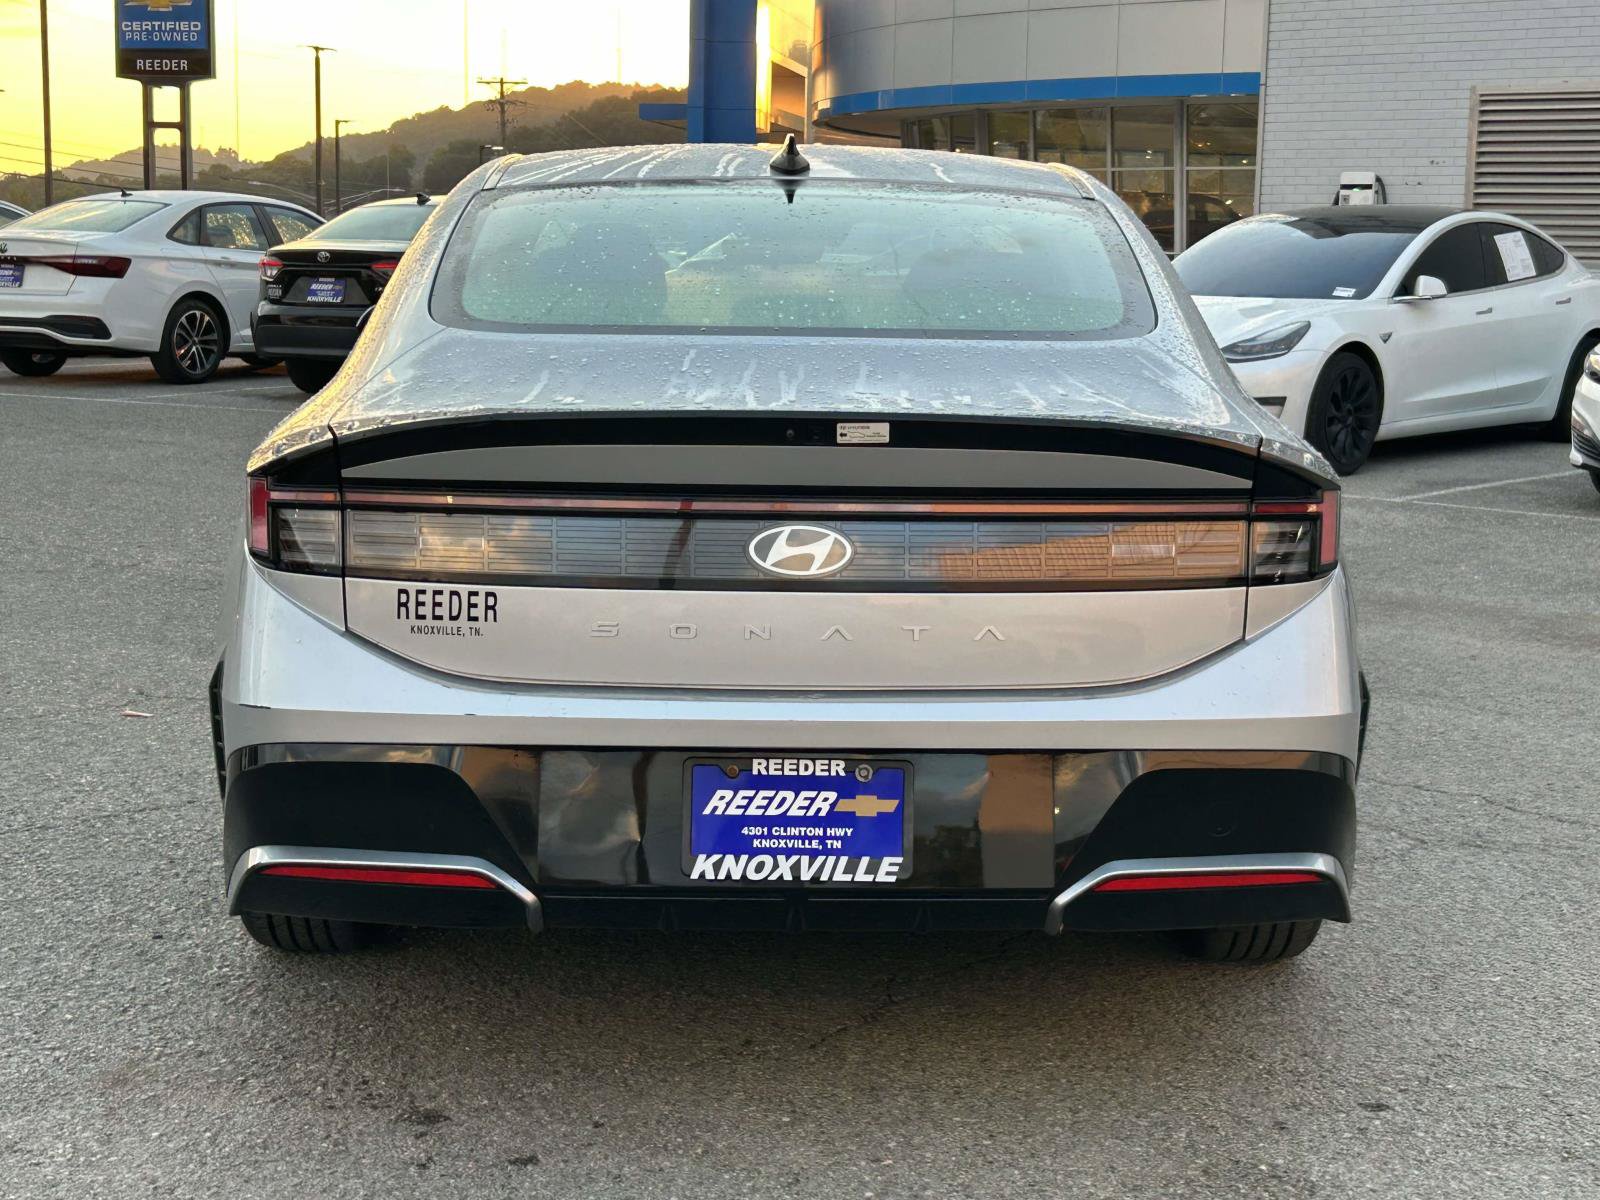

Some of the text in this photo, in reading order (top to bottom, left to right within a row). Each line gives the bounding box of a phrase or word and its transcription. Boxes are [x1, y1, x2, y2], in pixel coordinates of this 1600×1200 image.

[121, 21, 202, 31] CERTIFIED
[125, 32, 198, 41] PRE-OWNED
[136, 59, 188, 71] REEDER
[397, 588, 498, 622] REEDER
[410, 625, 484, 637] KNOXVILLE, TN.
[590, 621, 1006, 641] SONATA
[752, 758, 846, 776] REEDER
[702, 789, 838, 817] REEDER
[741, 826, 853, 837] 4301 CLINTON HWY
[753, 838, 842, 850] KNOXVILLE, TN
[690, 853, 904, 882] KNOXVILLE
